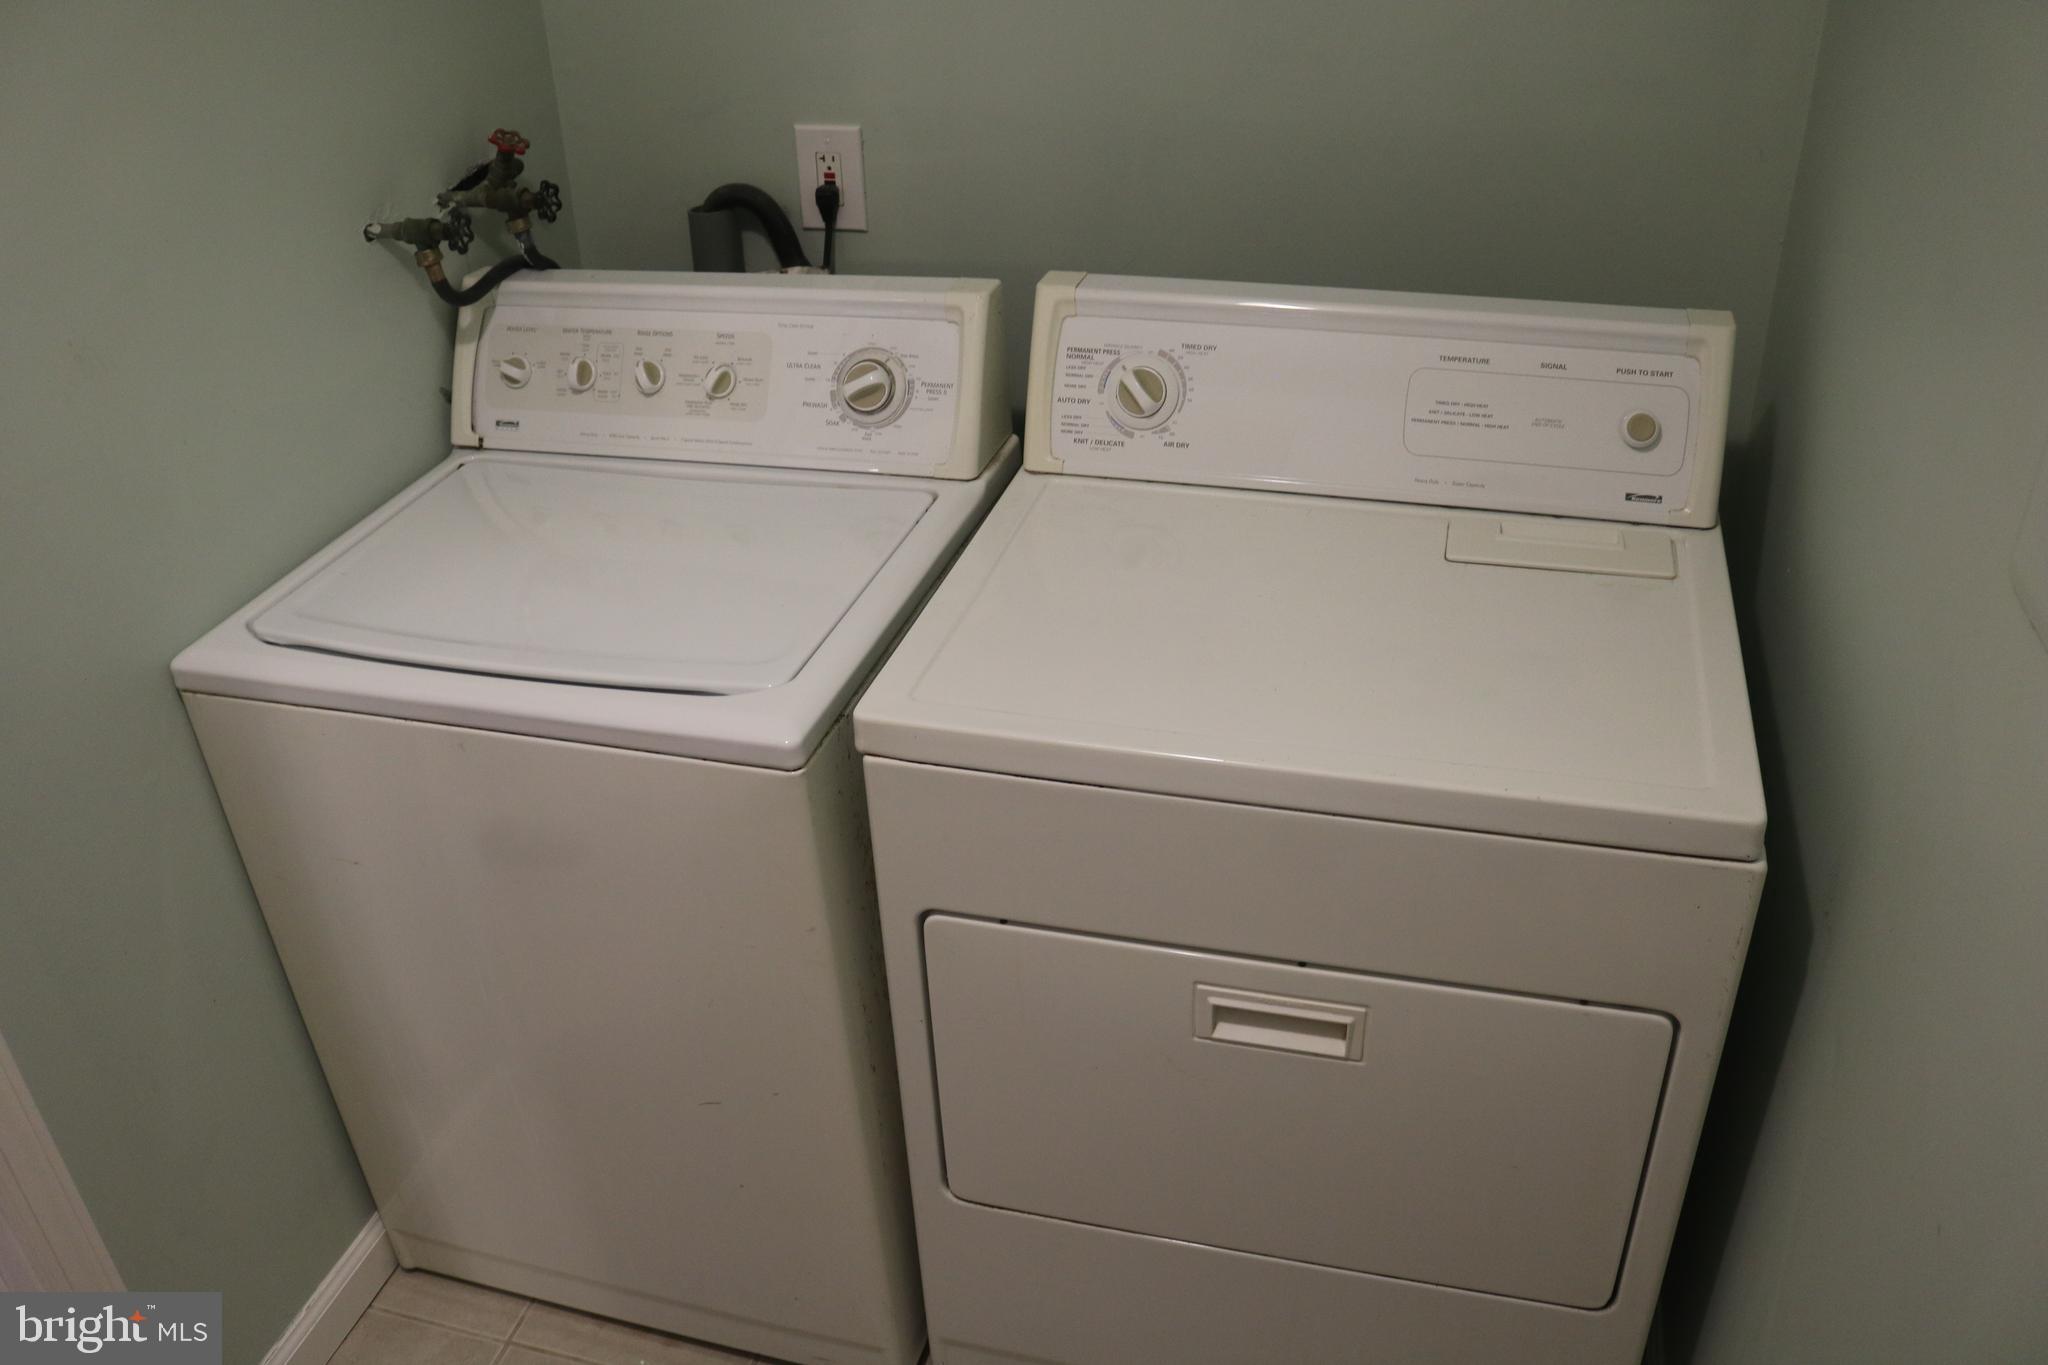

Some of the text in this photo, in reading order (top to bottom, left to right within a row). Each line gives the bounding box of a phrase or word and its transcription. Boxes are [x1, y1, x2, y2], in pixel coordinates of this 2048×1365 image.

[1066, 345, 1101, 355] PERMANENT
[1102, 348, 1121, 357] PRESS
[1181, 342, 1202, 352] TIMED
[1203, 344, 1218, 353] DRY
[1066, 352, 1096, 361] NORMAL
[1439, 354, 1491, 365] TEMPERATURE
[1540, 361, 1567, 371] SIGNAL
[1616, 367, 1674, 378] PUSH TO START
[921, 381, 954, 390] PERMANENT
[1057, 396, 1091, 406] AUTO DRY
[1073, 437, 1089, 446] KNIT
[1094, 439, 1125, 448] DELICATE
[1163, 440, 1190, 450] AIR DRY
